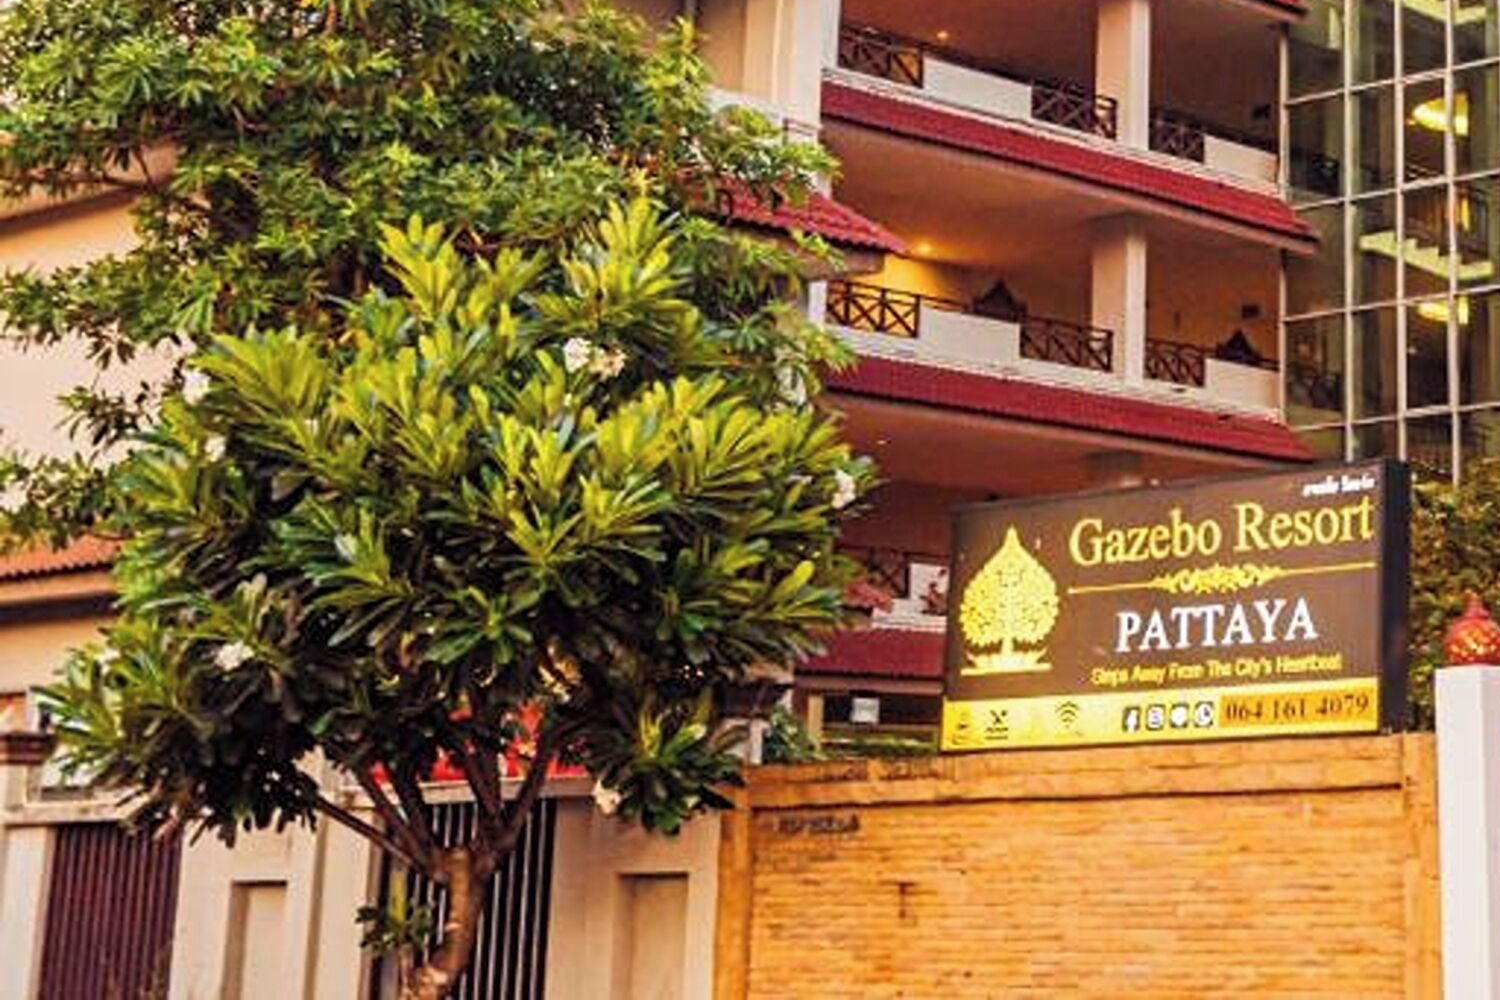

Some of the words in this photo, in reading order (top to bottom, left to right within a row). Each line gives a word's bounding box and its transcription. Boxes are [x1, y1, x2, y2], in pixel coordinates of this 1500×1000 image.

[1068, 508, 1221, 567] Gazebo
[1233, 495, 1375, 552] Resort
[1114, 597, 1319, 653] PATTAYA
[1130, 664, 1167, 685] Away
[1169, 662, 1204, 680] From
[1206, 660, 1231, 677] The
[1234, 656, 1272, 679] City's
[1226, 701, 1263, 721] 064
[1273, 698, 1306, 720] 161
[1315, 693, 1369, 716] 4079
